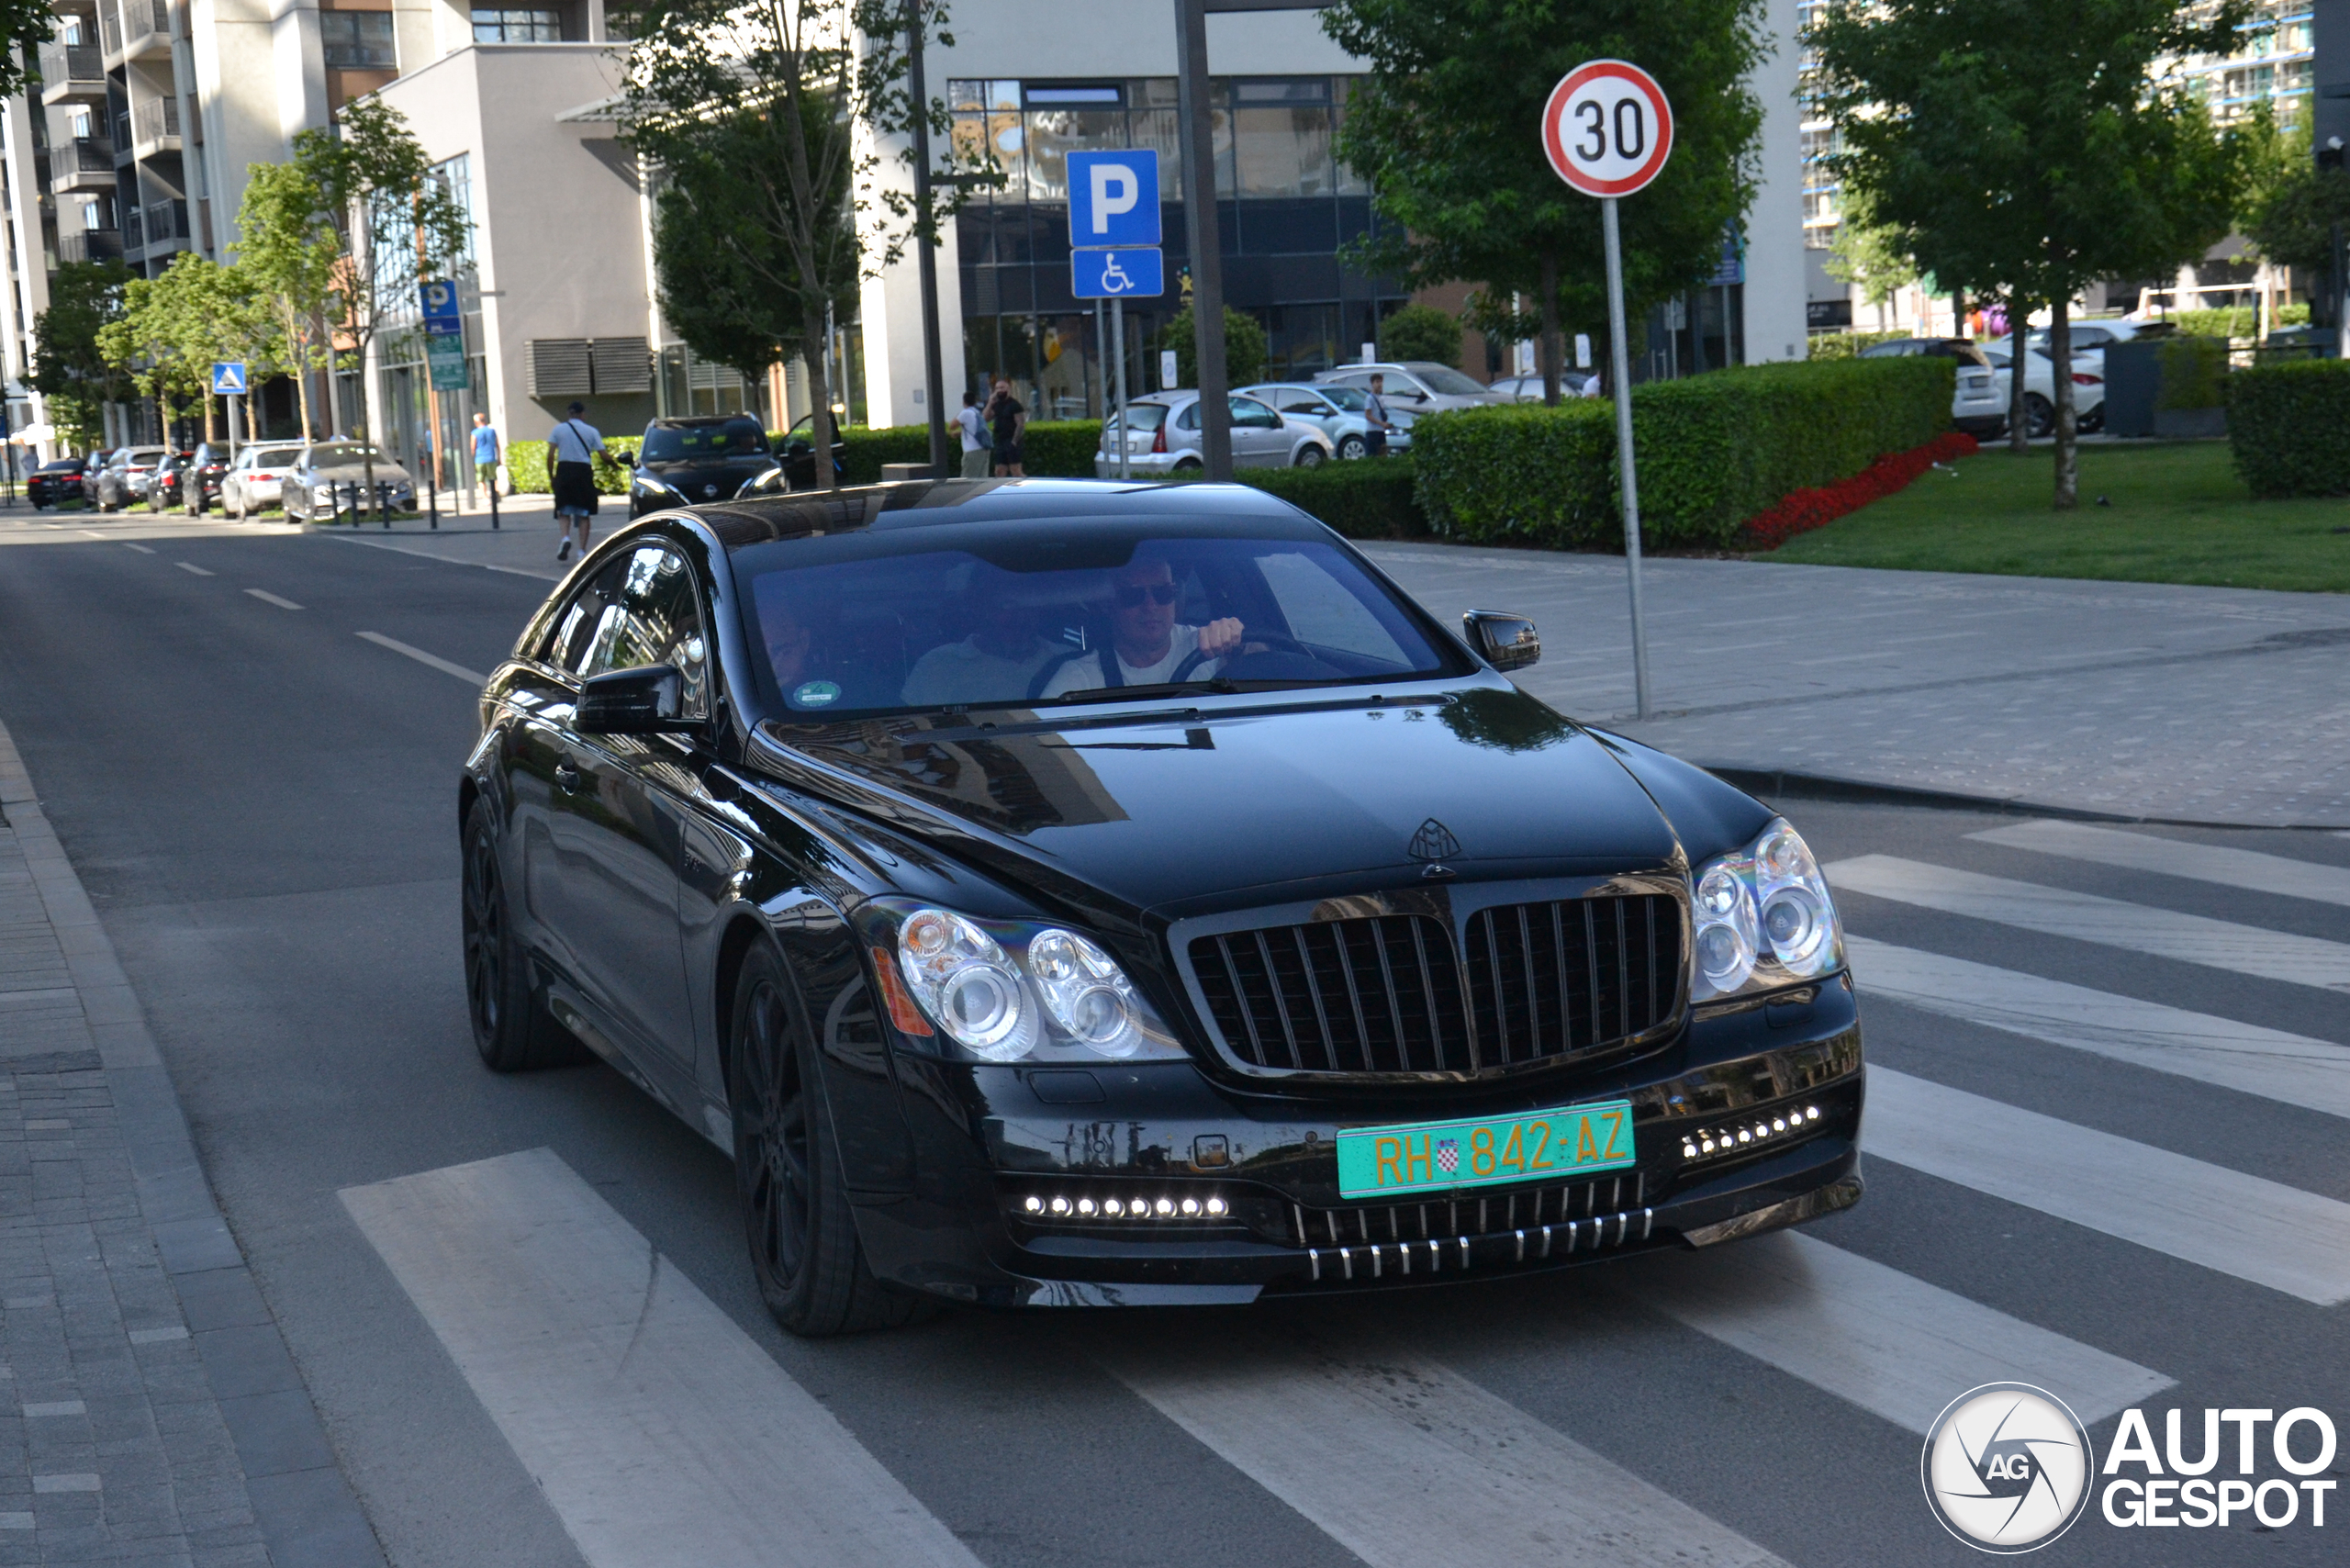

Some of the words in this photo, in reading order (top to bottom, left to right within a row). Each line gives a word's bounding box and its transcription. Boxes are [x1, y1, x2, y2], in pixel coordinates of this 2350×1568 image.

[1574, 97, 1644, 162] 30
[1090, 163, 1138, 234] P
[428, 286, 449, 313] P
[812, 684, 823, 695] 4
[1375, 1133, 1433, 1185] RH
